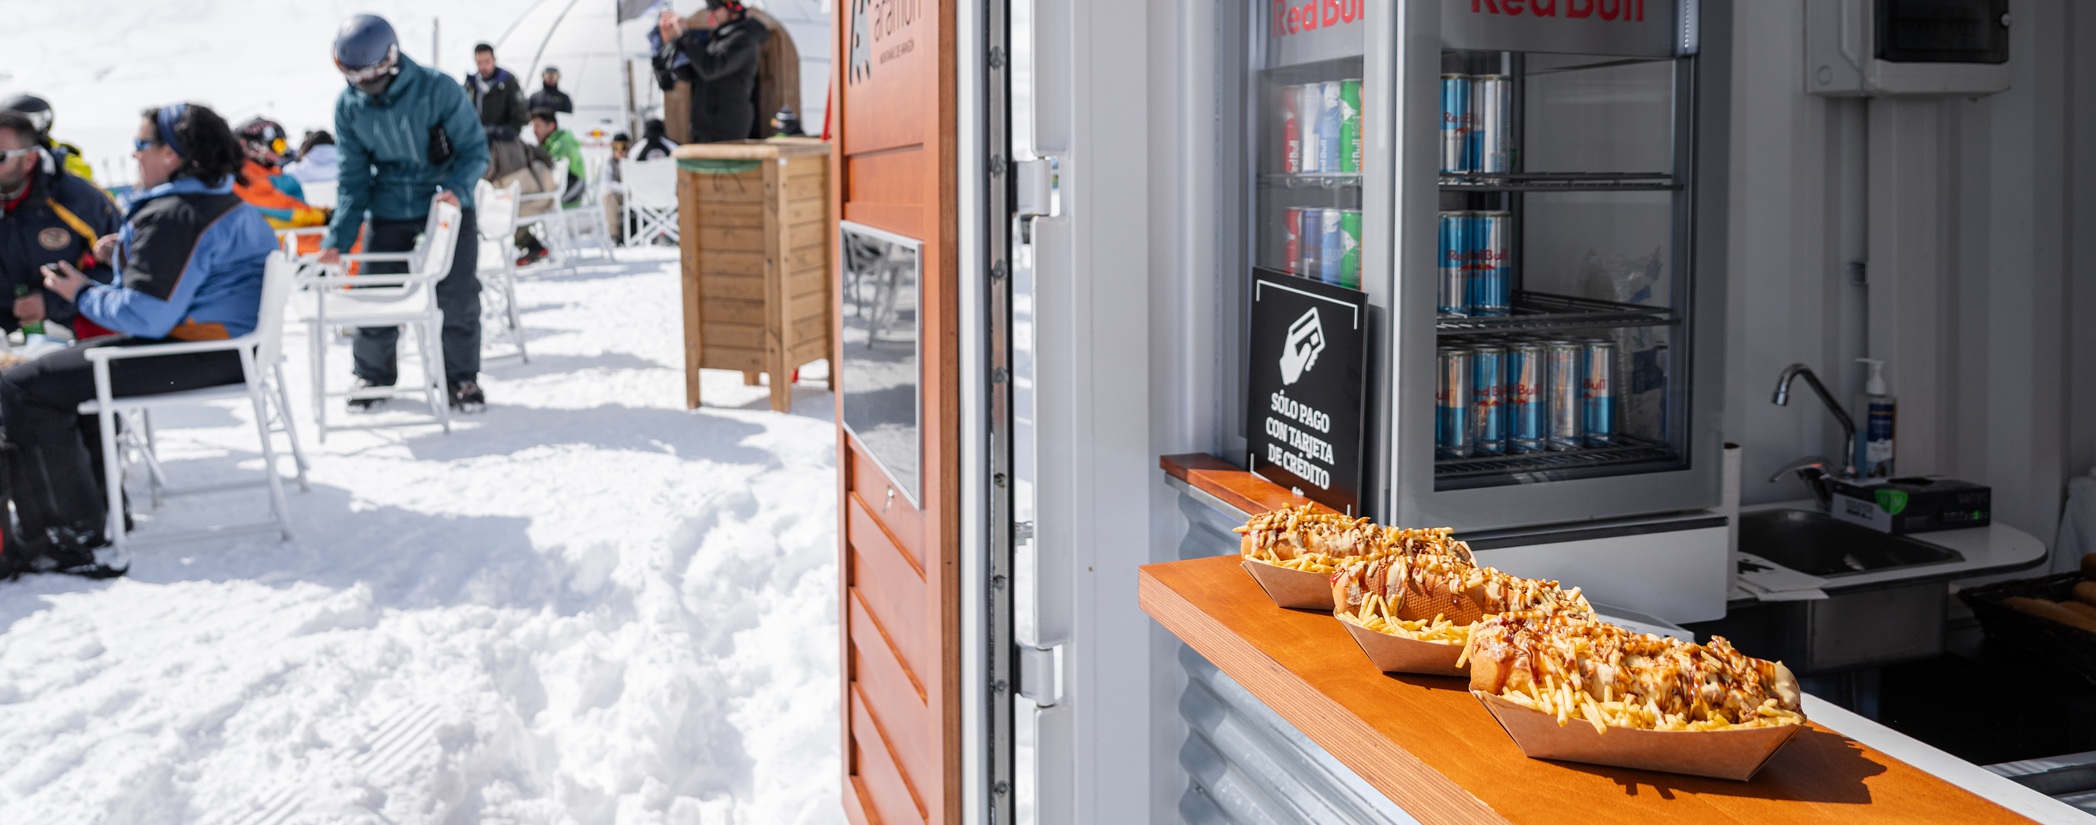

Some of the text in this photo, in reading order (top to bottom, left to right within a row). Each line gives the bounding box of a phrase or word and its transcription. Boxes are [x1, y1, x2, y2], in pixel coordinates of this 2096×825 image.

[1273, 0, 1364, 38] Red Bul
[1485, 248, 1507, 260] Bull
[1473, 385, 1490, 397] ed
[1517, 384, 1541, 396] Bull
[1271, 389, 1330, 434] SÓLO PAGO
[1265, 416, 1335, 465] CON TARJETA
[1267, 443, 1330, 490] DE CRÉDITO
